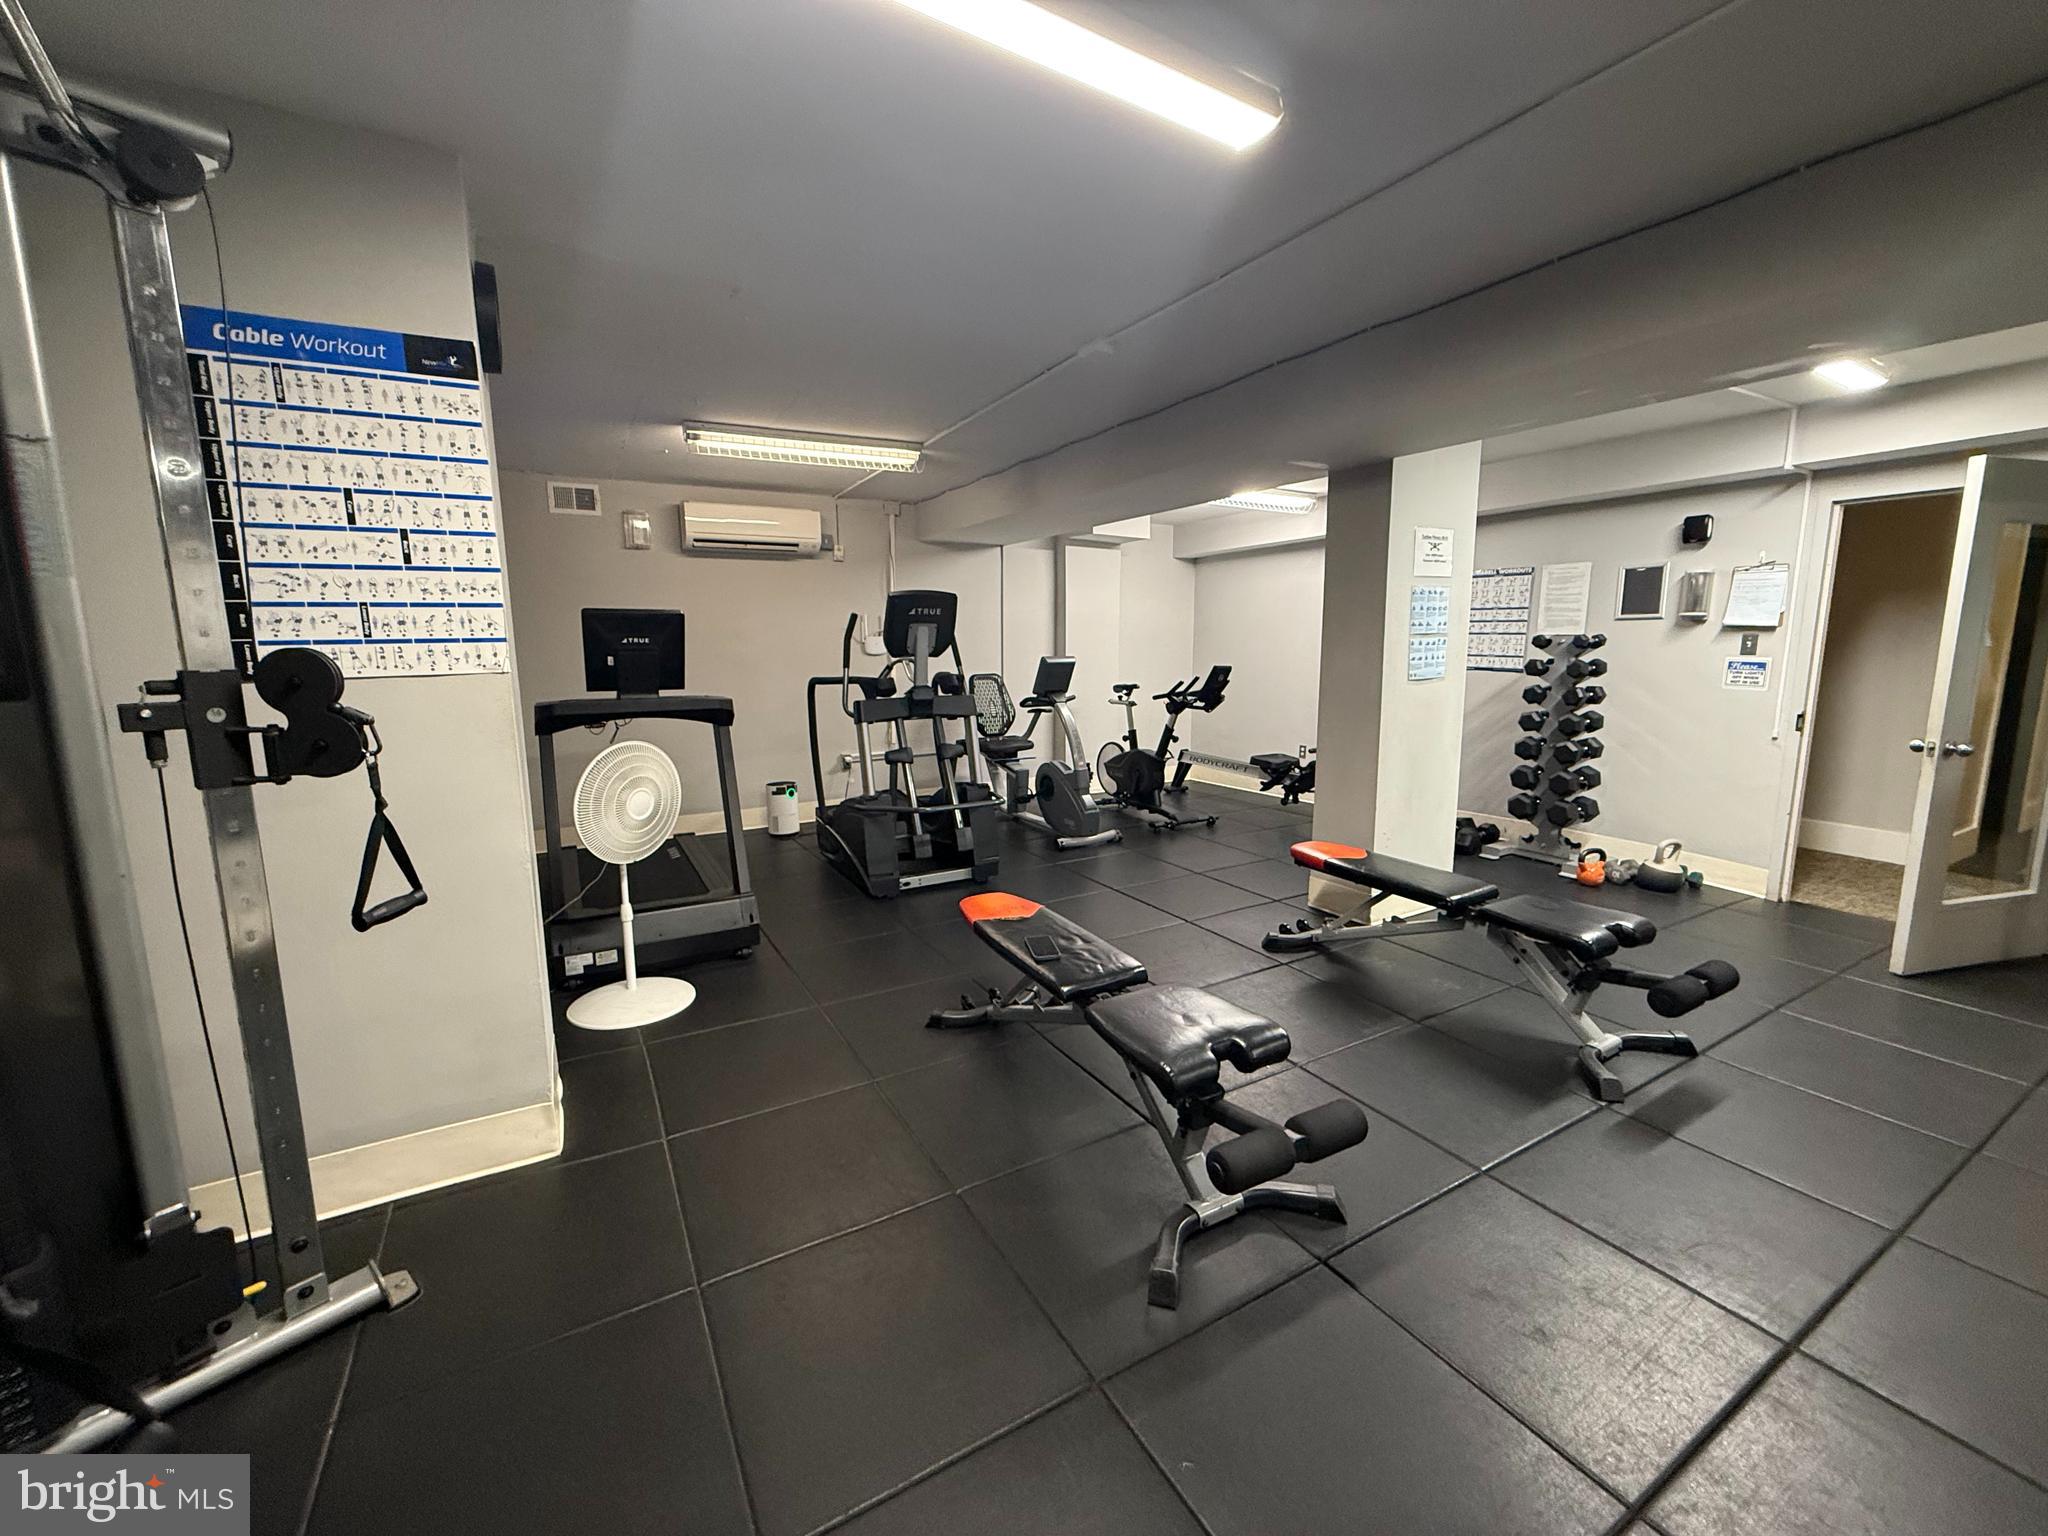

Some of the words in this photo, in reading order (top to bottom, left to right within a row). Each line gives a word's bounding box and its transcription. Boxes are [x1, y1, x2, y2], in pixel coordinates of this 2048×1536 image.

[212, 322, 285, 347] Cable
[290, 332, 387, 360] Workout
[200, 375, 209, 392] Body
[272, 366, 281, 385] Upper
[275, 384, 284, 399] Body
[204, 400, 213, 419] Upper
[207, 418, 216, 434] Body
[211, 443, 220, 461] Upper
[214, 461, 222, 477] Body
[218, 484, 226, 502] Upper
[221, 501, 229, 517] Body
[346, 500, 354, 513] Core
[225, 534, 234, 549] Core
[232, 574, 241, 589] Back
[361, 605, 369, 622] Lower
[917, 607, 942, 615] TRUE
[362, 621, 371, 636] Body
[243, 643, 252, 661] Lower
[246, 661, 255, 675] Body
[1189, 755, 1249, 773] BODYCRAFT
